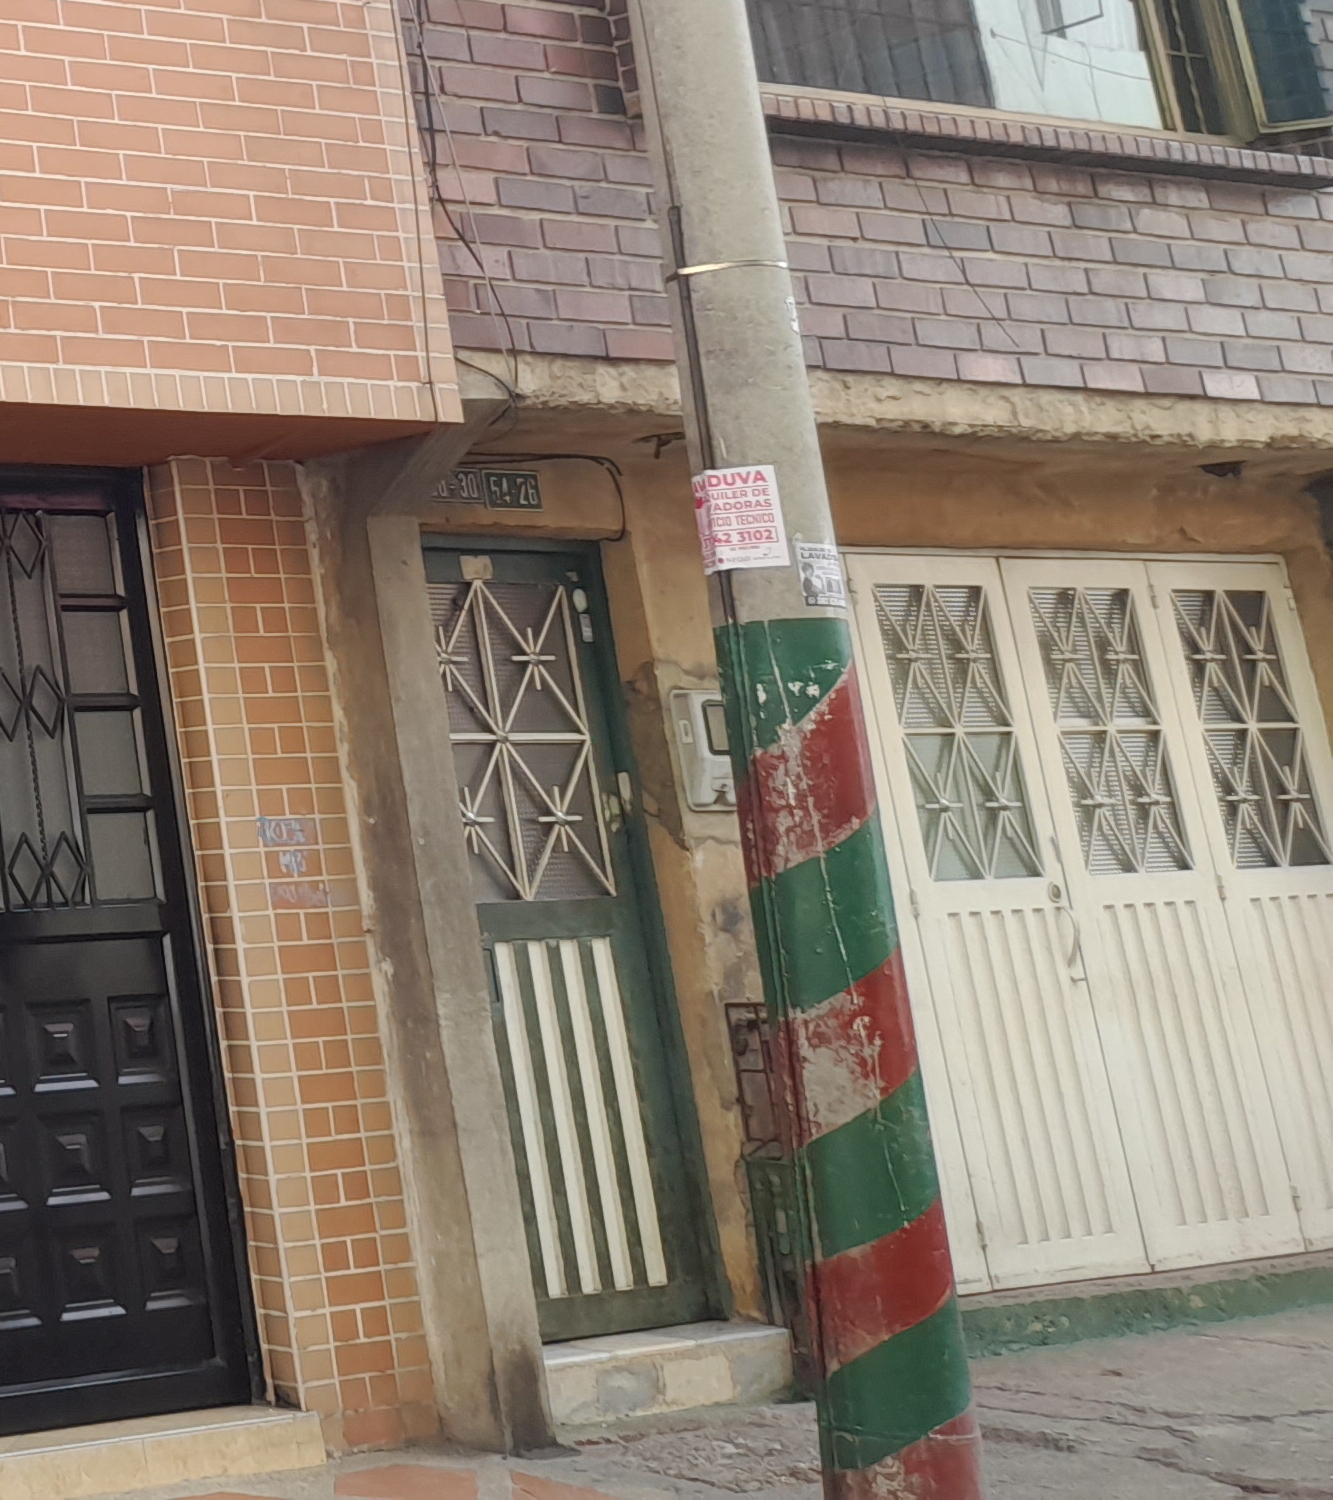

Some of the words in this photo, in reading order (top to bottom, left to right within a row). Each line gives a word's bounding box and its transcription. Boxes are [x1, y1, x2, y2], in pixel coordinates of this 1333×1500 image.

[711, 490, 748, 501] UILER
[751, 488, 770, 497] DE
[712, 499, 772, 512] ADORAS
[737, 529, 774, 542] 3102
